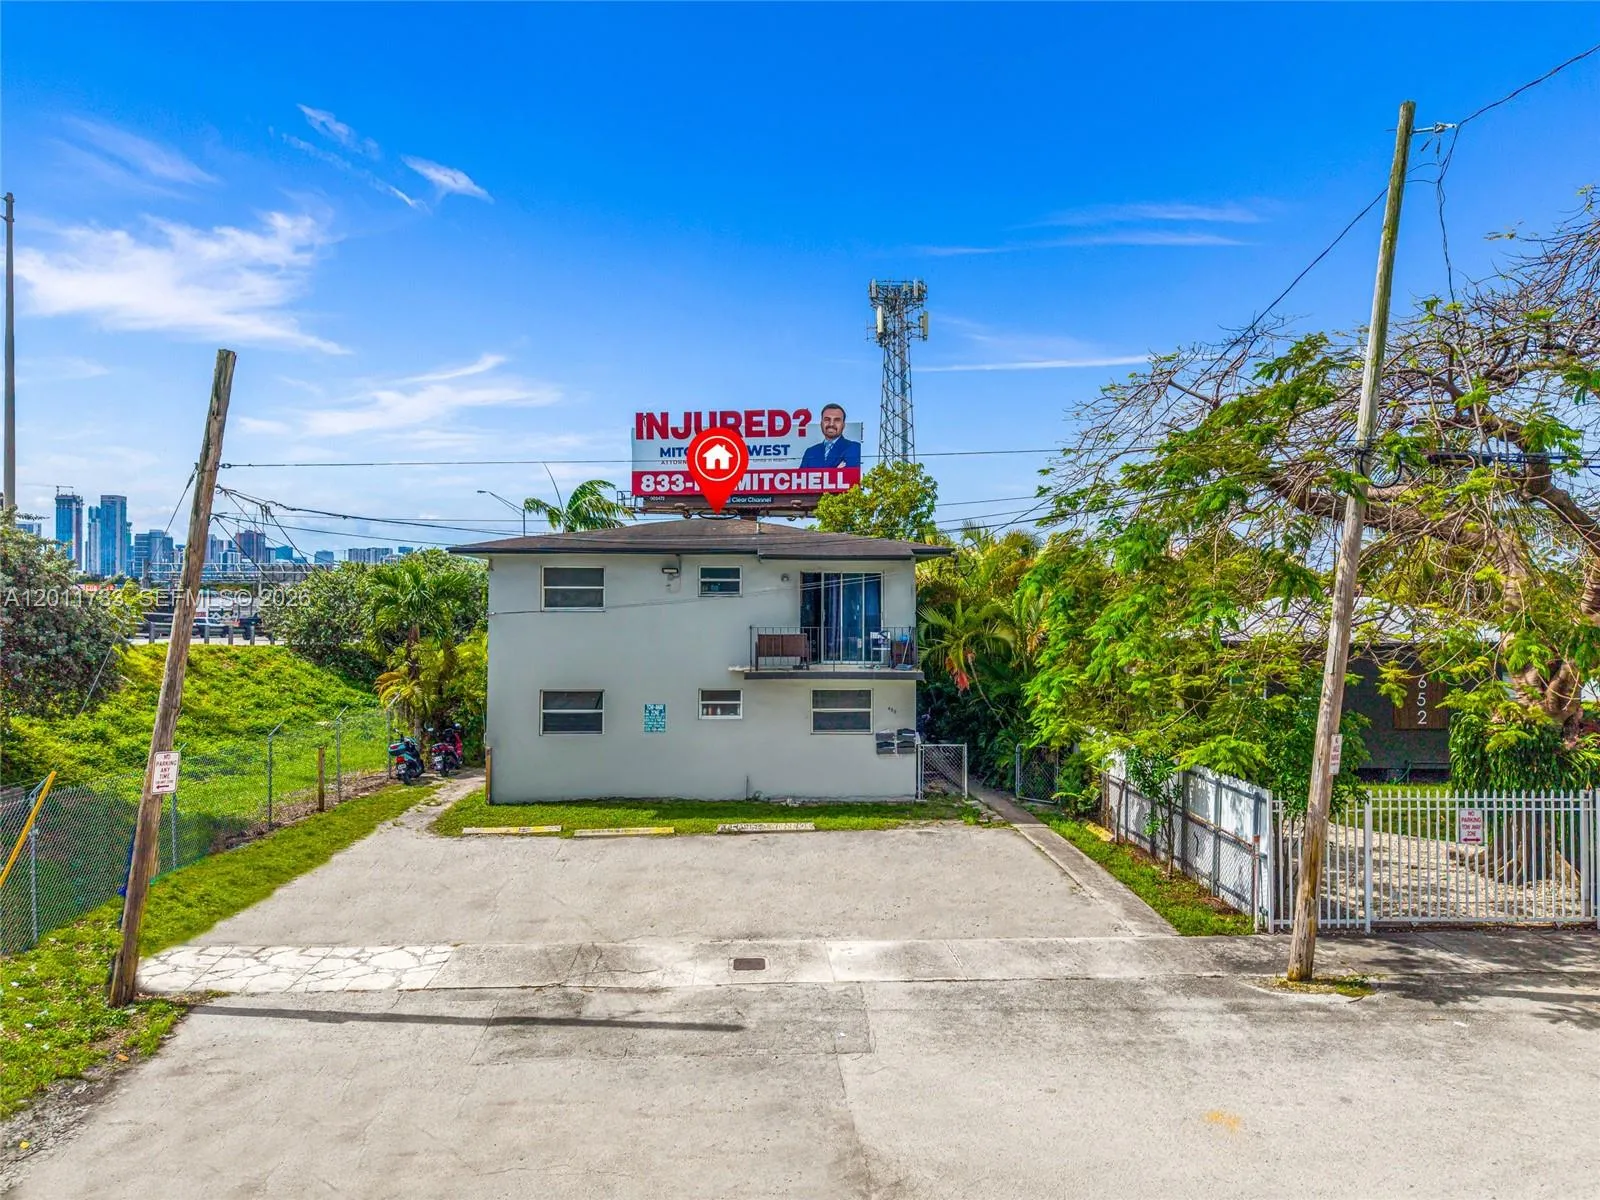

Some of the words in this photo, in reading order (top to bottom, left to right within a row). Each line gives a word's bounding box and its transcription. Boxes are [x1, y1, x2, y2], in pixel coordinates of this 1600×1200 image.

[635, 409, 812, 440] INJURED?
[747, 444, 790, 456] WEST
[1416, 675, 1427, 725] 652
